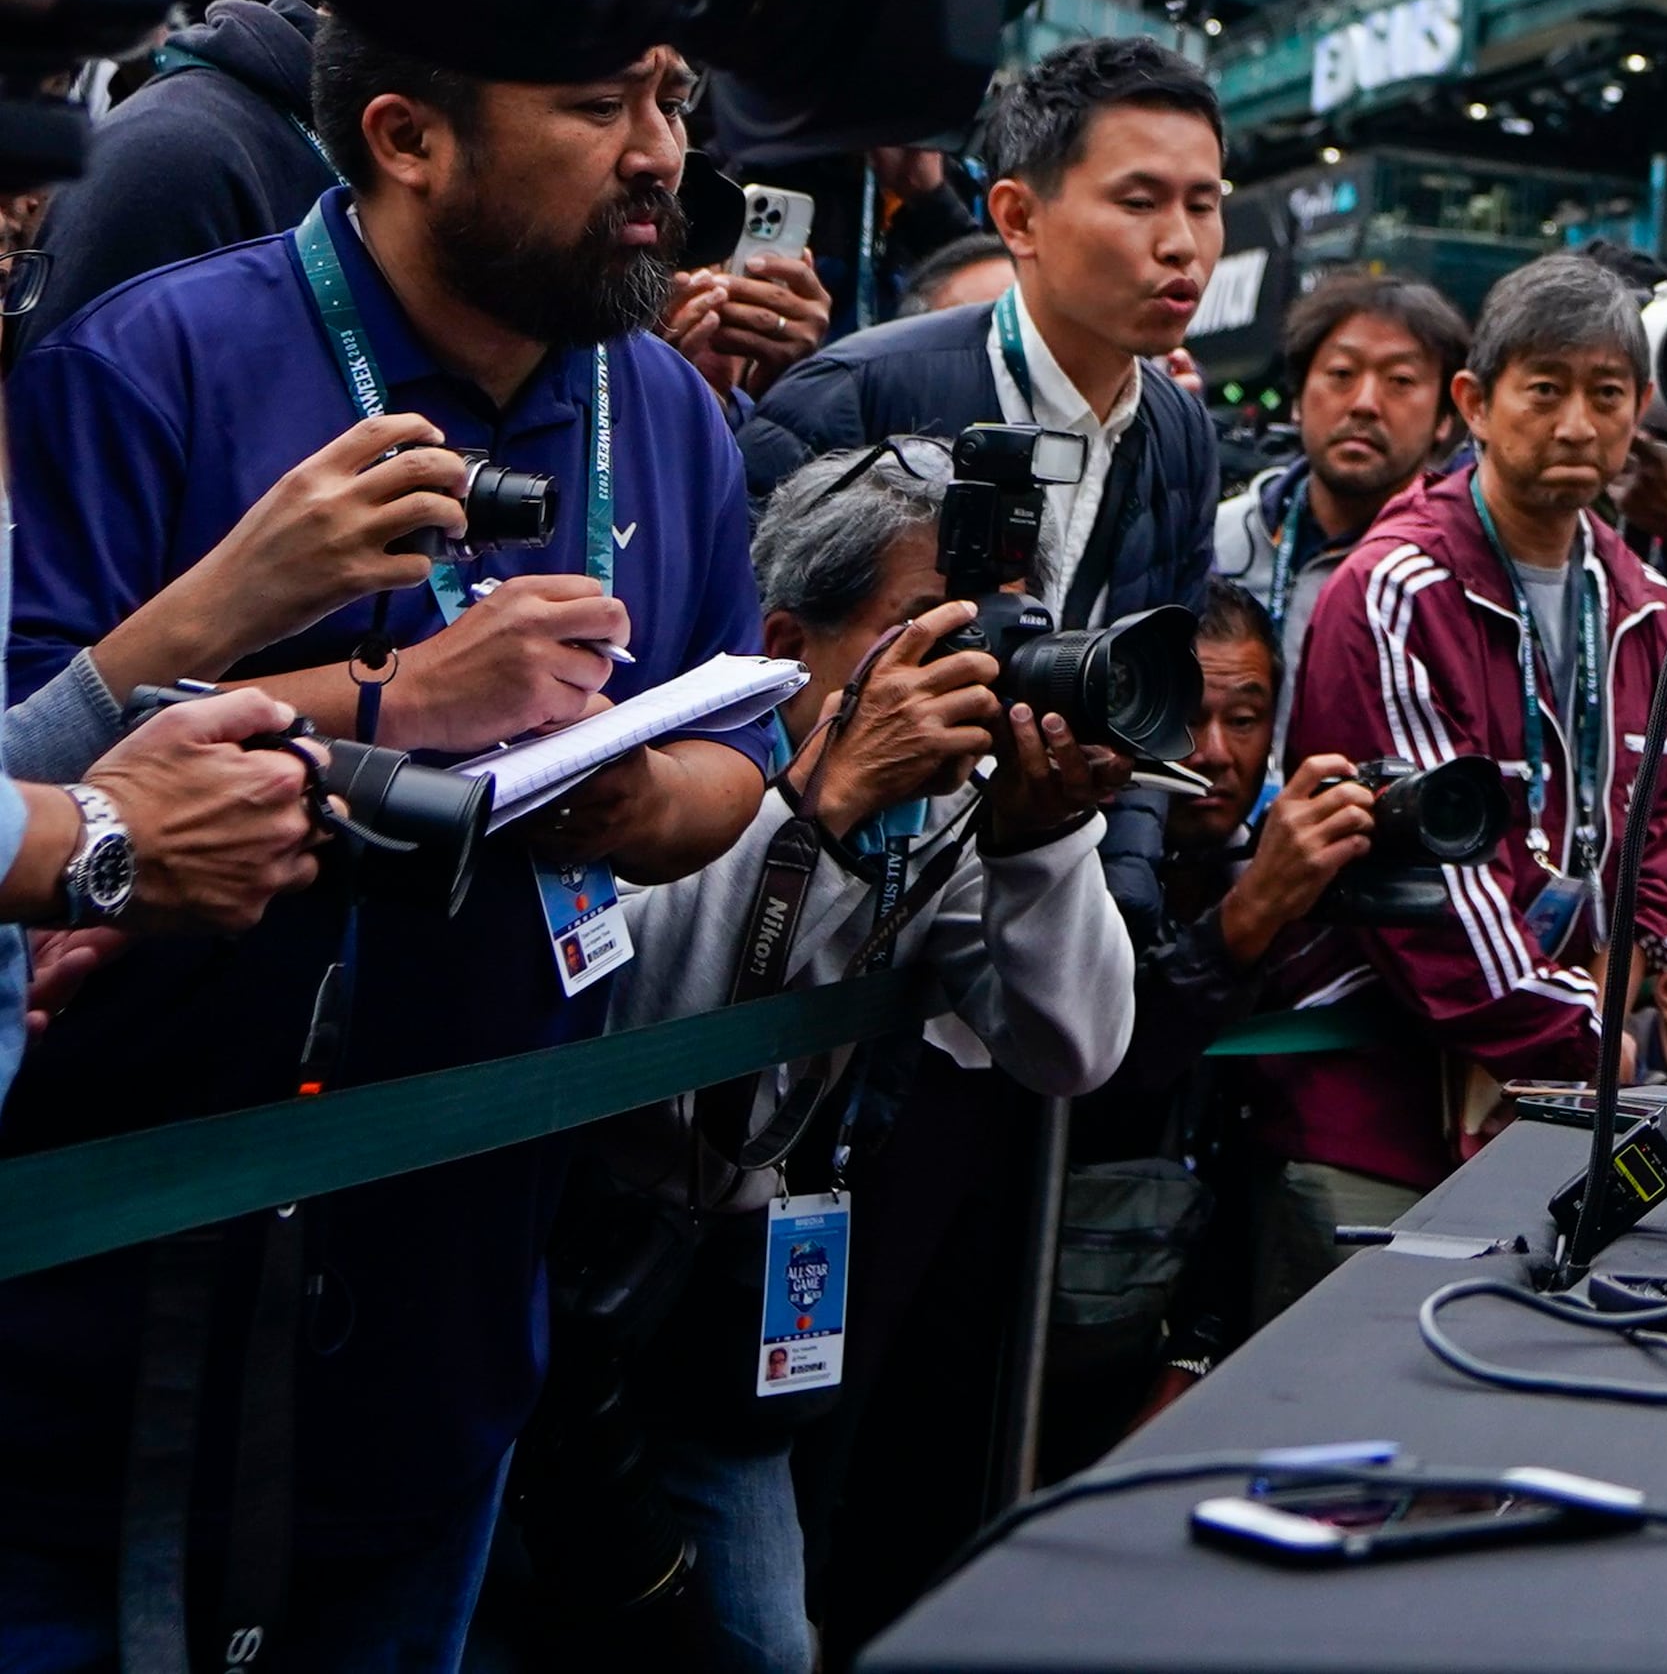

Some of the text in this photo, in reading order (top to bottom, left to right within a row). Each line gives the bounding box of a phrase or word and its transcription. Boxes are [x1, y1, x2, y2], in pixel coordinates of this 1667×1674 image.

[340, 329, 361, 357] 2023
[348, 355, 380, 409] WEEK
[597, 357, 609, 390] ALL
[597, 390, 610, 430] STAR
[596, 429, 612, 473] WEEK
[1019, 613, 1048, 626] Nikon
[887, 851, 902, 876] ALL
